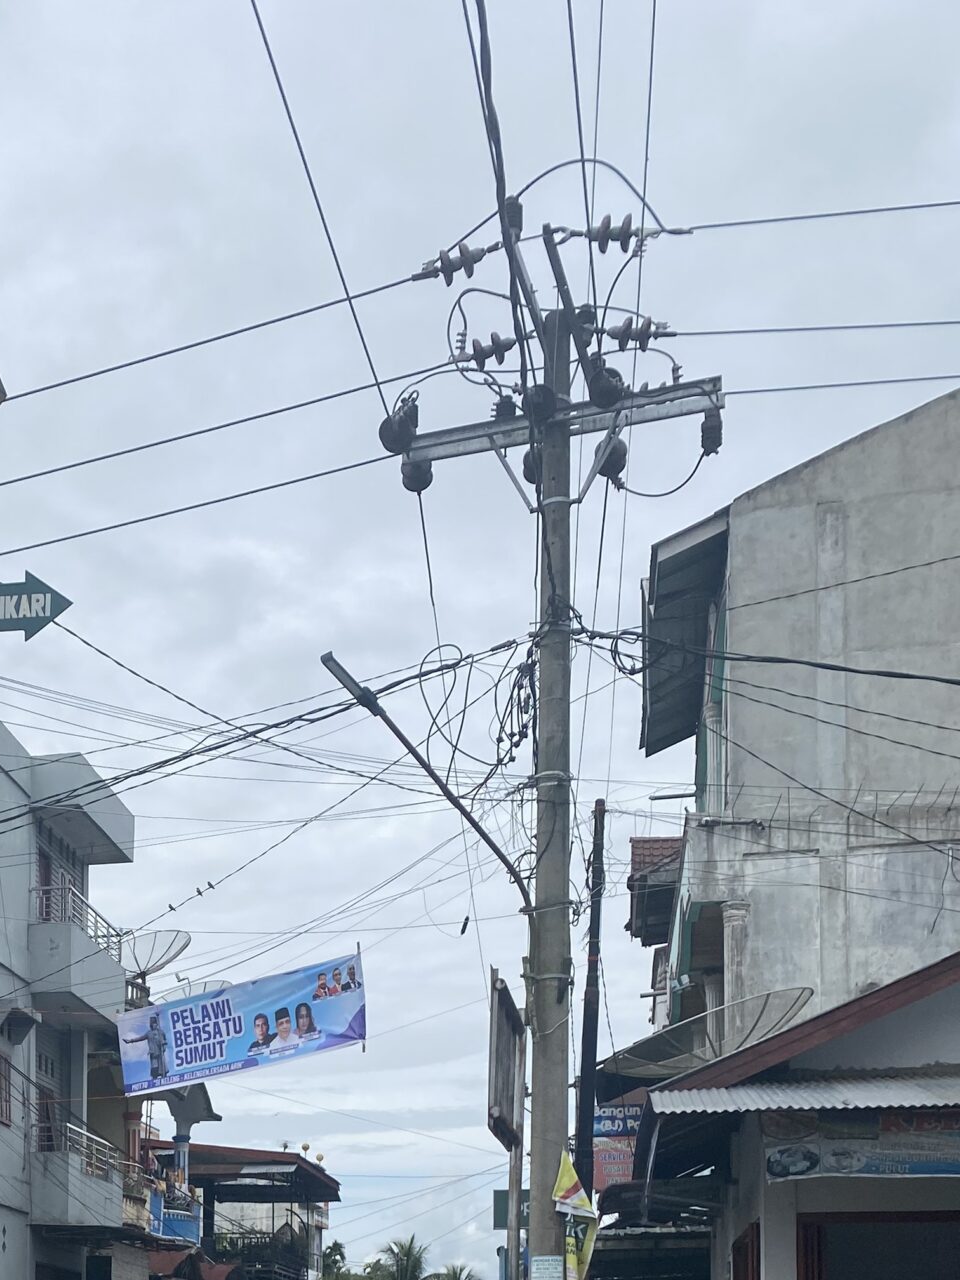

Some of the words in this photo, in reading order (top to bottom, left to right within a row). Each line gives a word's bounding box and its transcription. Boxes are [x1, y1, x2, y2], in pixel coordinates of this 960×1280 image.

[171, 999, 233, 1029] PELAWI
[174, 1016, 243, 1047] BERSATU
[175, 1040, 226, 1067] SUMUT
